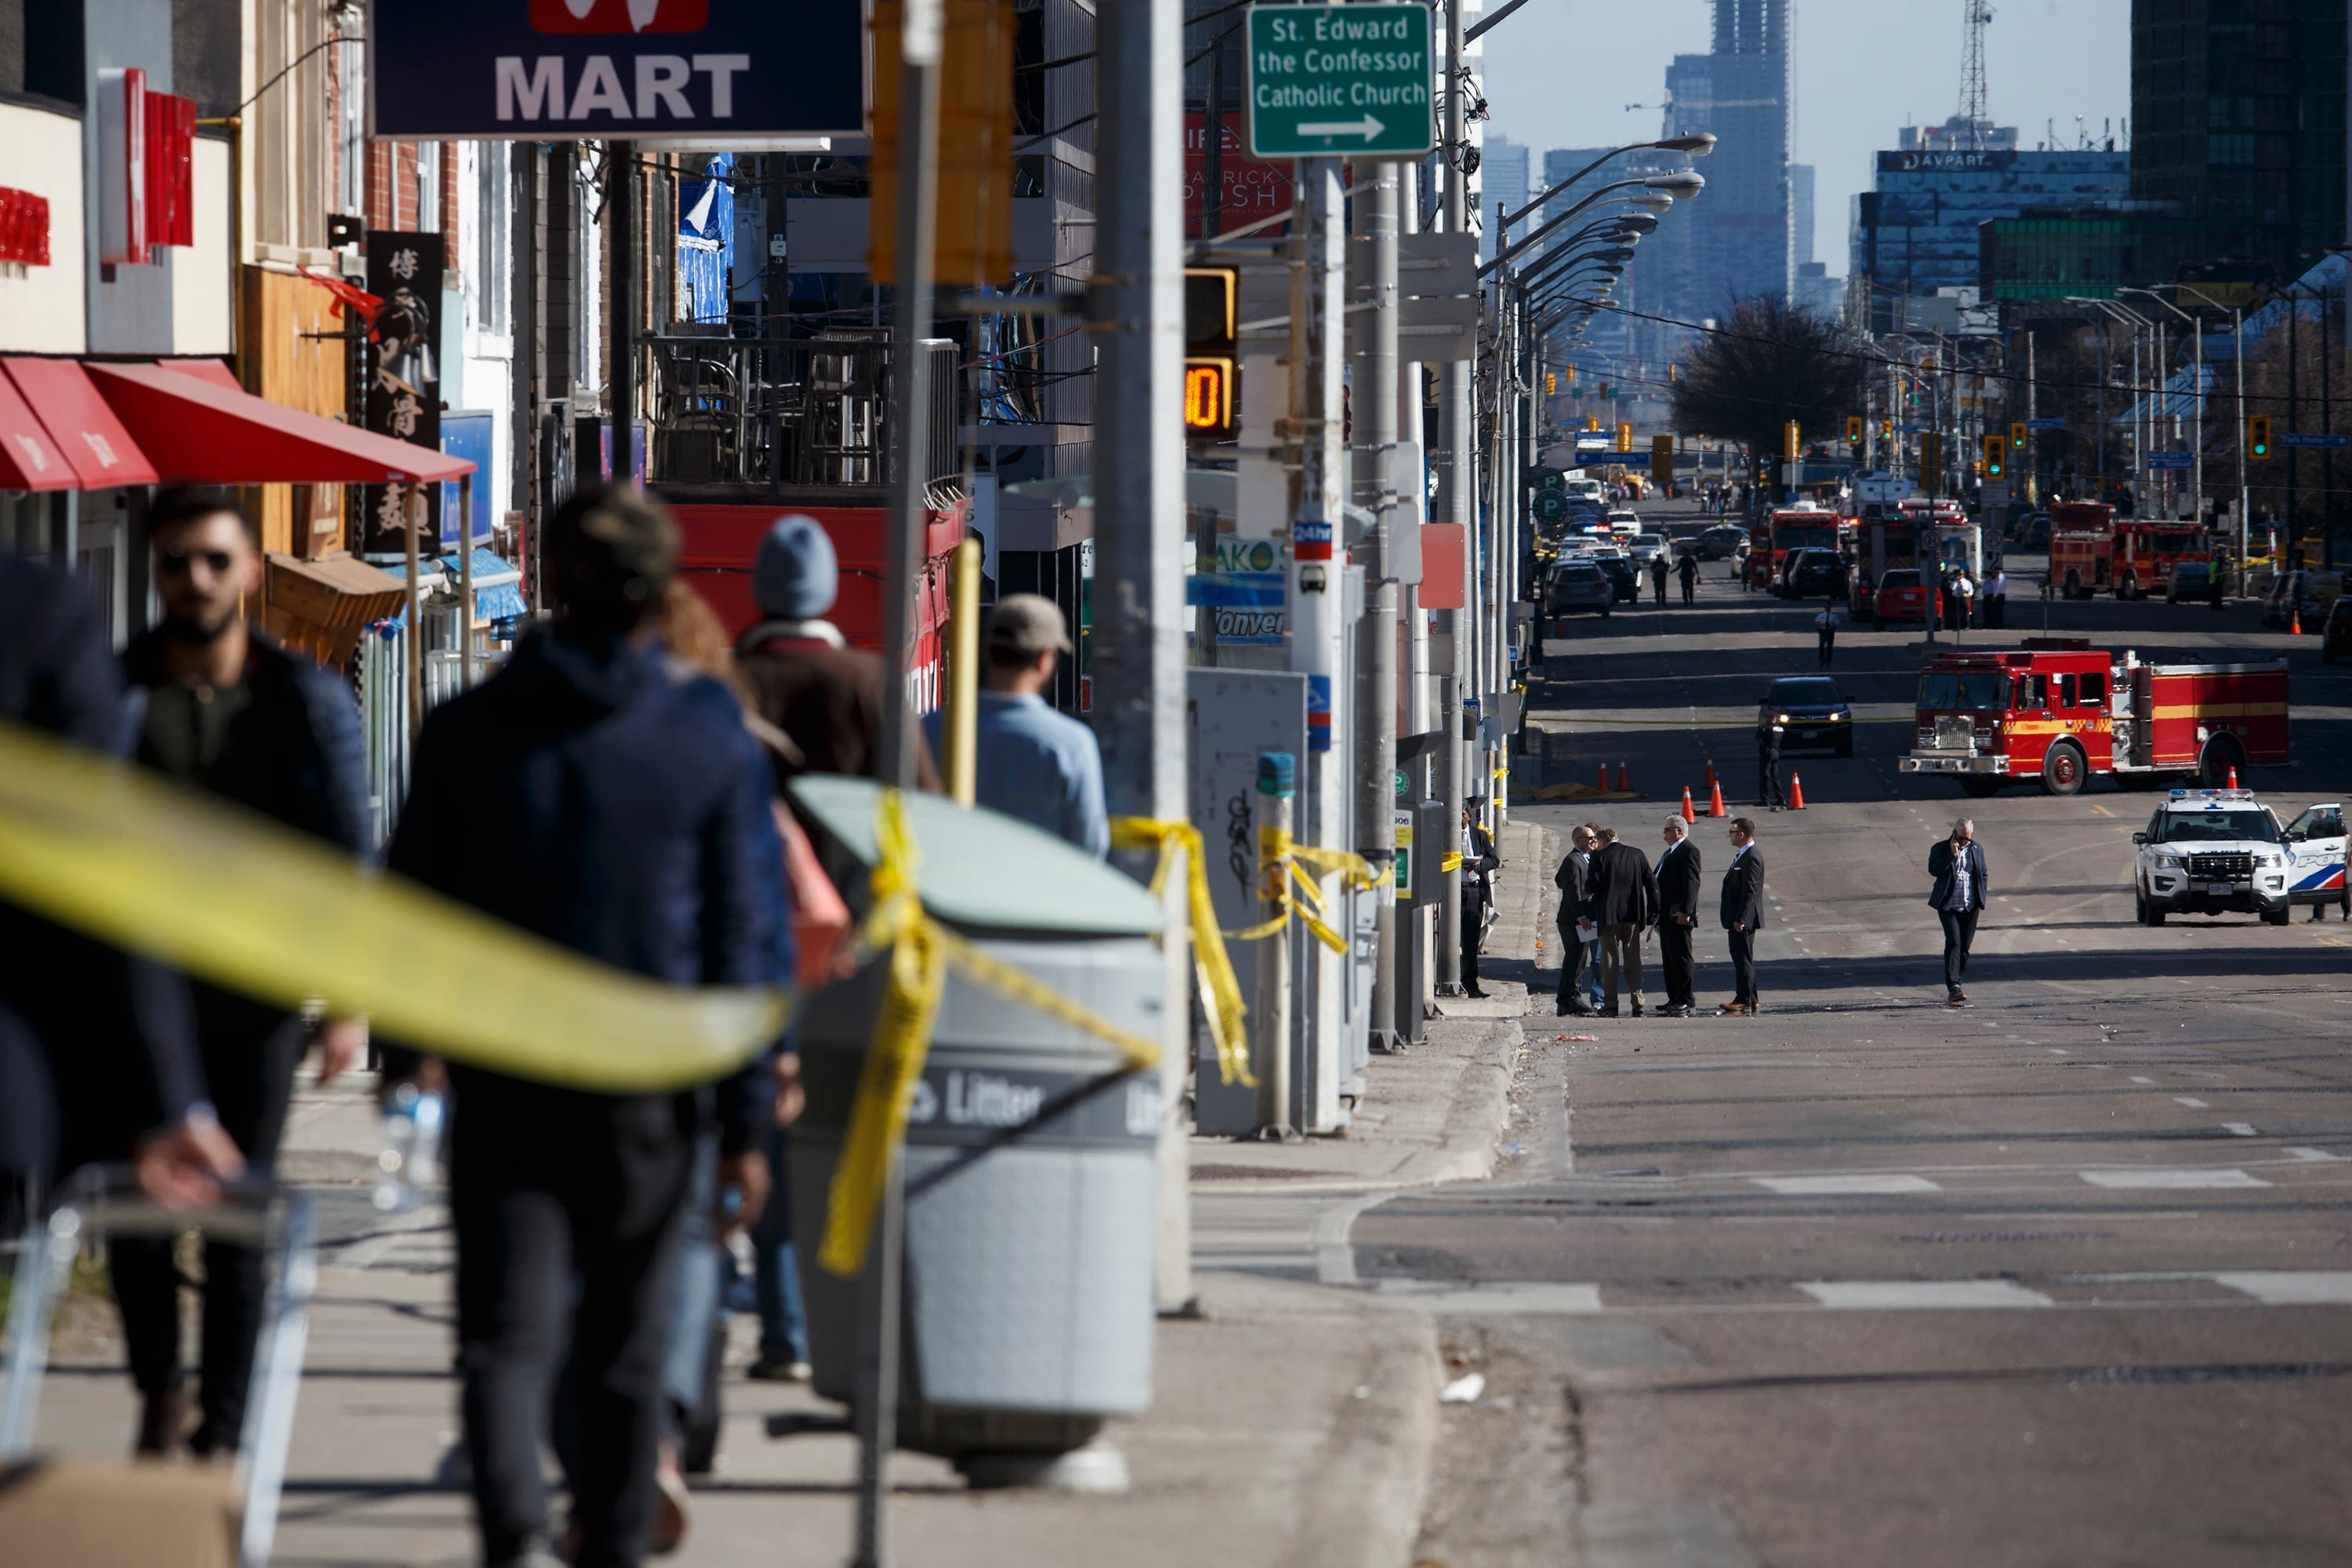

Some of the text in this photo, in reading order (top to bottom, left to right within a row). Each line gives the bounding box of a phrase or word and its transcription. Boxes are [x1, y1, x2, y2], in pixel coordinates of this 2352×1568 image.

[1272, 16, 1408, 42] St. Edward
[1258, 48, 1421, 74] the Confessor
[495, 53, 750, 121] MART
[1256, 82, 1426, 108] Catholic Church
[1181, 128, 1241, 149] IFE.
[1181, 170, 1275, 184] PARICK
[1181, 184, 1276, 207] PSH
[1601, 453, 1636, 463] Empress
[1545, 475, 1557, 487] P
[1544, 499, 1557, 513] P
[1295, 524, 1330, 541] 24hr
[1216, 542, 1274, 572] AKO
[945, 1069, 1047, 1127] Litter
